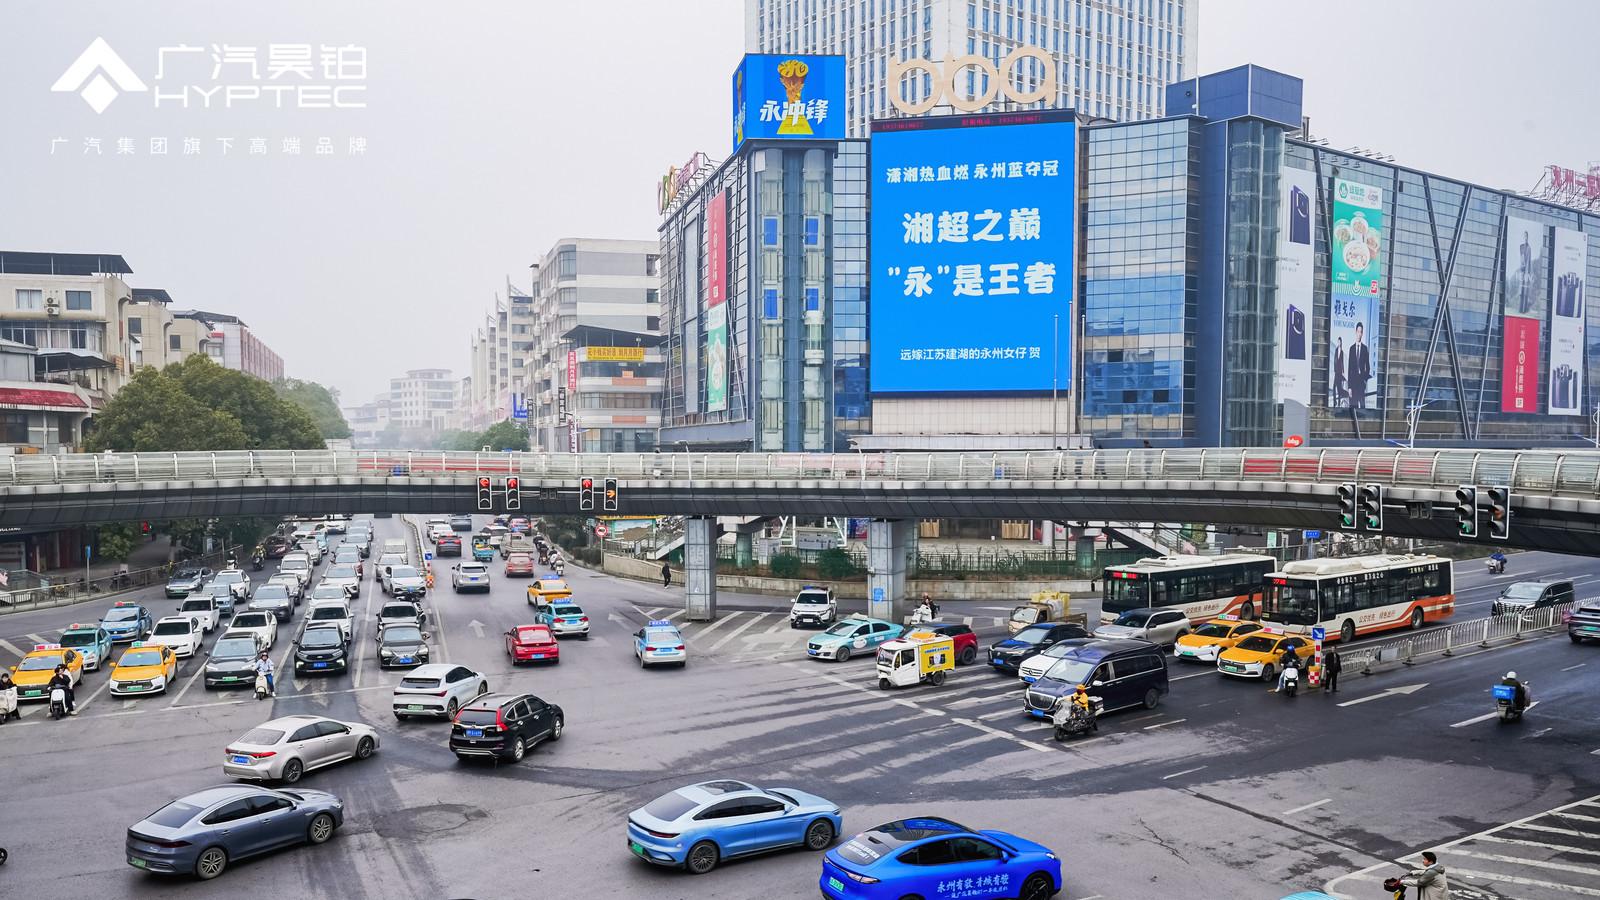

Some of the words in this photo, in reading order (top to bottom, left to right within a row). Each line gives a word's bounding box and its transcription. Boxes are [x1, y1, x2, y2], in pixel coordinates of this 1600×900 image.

[759, 98, 829, 127] 永冲锋
[886, 164, 969, 184] 潇湘热血燃
[973, 159, 1059, 180] 永州蓝夺冠
[902, 207, 1041, 244] 湘超之巅
[900, 347, 1027, 361] 远嫁江苏建湖的永州女仔
[1029, 346, 1041, 359] 贺
